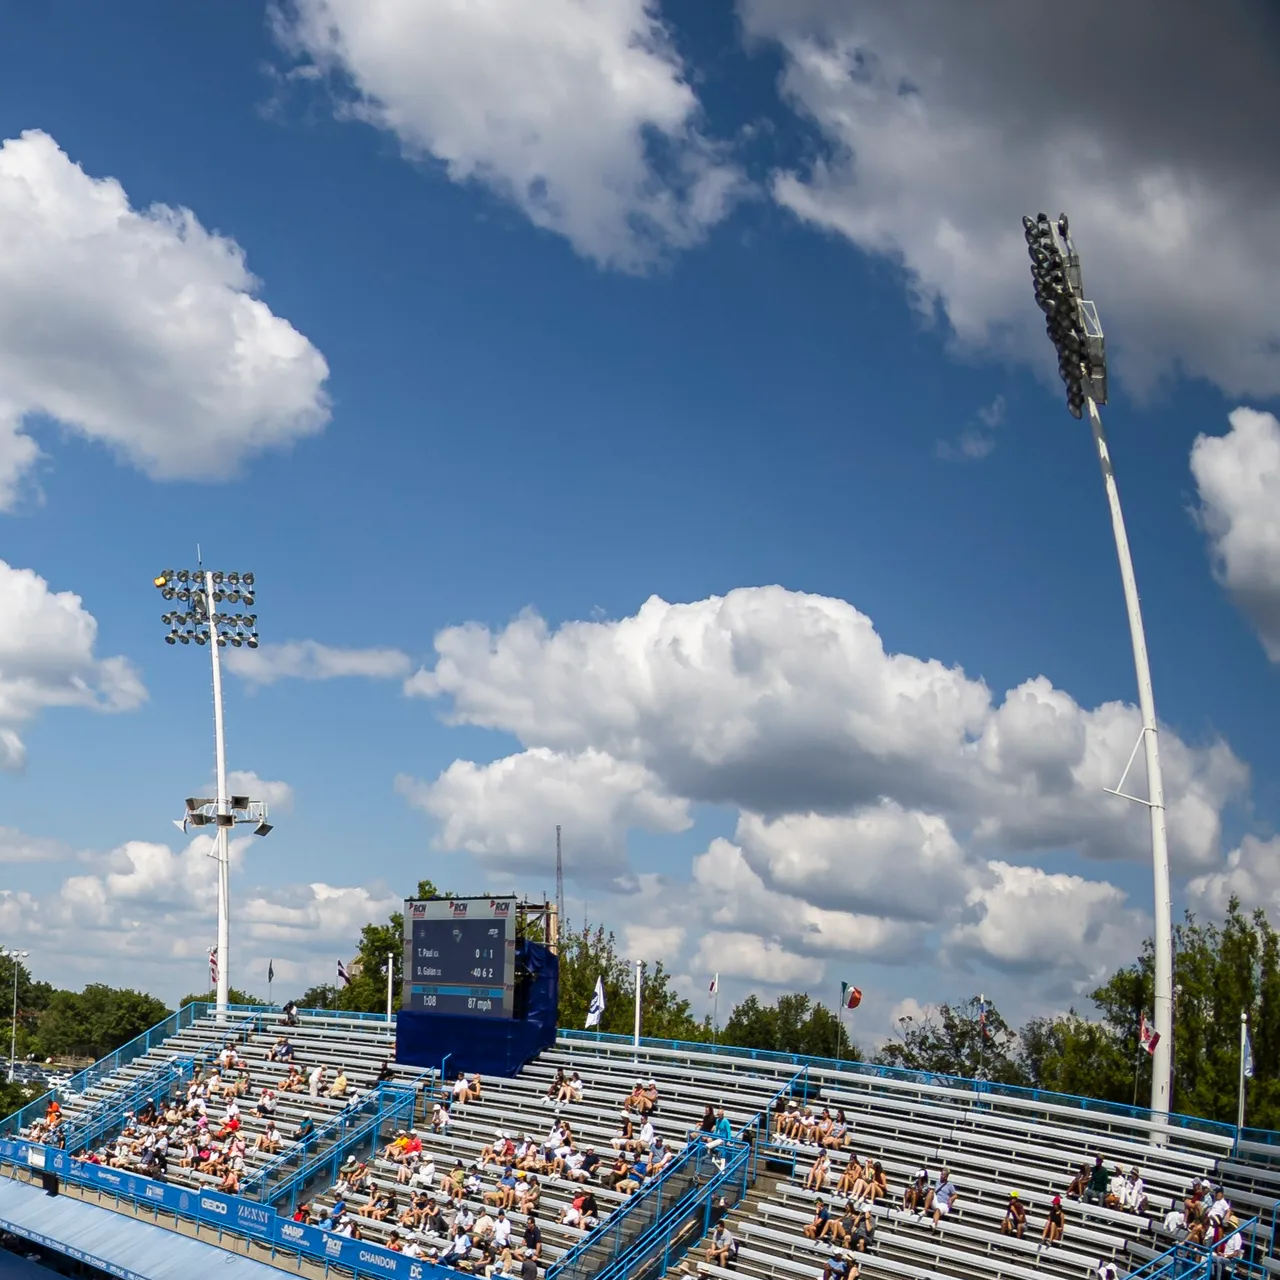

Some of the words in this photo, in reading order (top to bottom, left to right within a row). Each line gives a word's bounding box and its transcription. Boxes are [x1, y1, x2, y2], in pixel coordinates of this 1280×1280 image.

[413, 904, 426, 913] RCN
[454, 903, 468, 912] RCN
[495, 902, 510, 911] RCN
[423, 948, 433, 957] Paul
[423, 995, 437, 1006] 1:08
[468, 998, 476, 1009] 87
[477, 998, 491, 1011] mph
[201, 1199, 227, 1215] GEICO
[281, 1224, 304, 1239] AARP
[359, 1250, 396, 1270] CHANDON
[410, 1265, 422, 1279] DC
